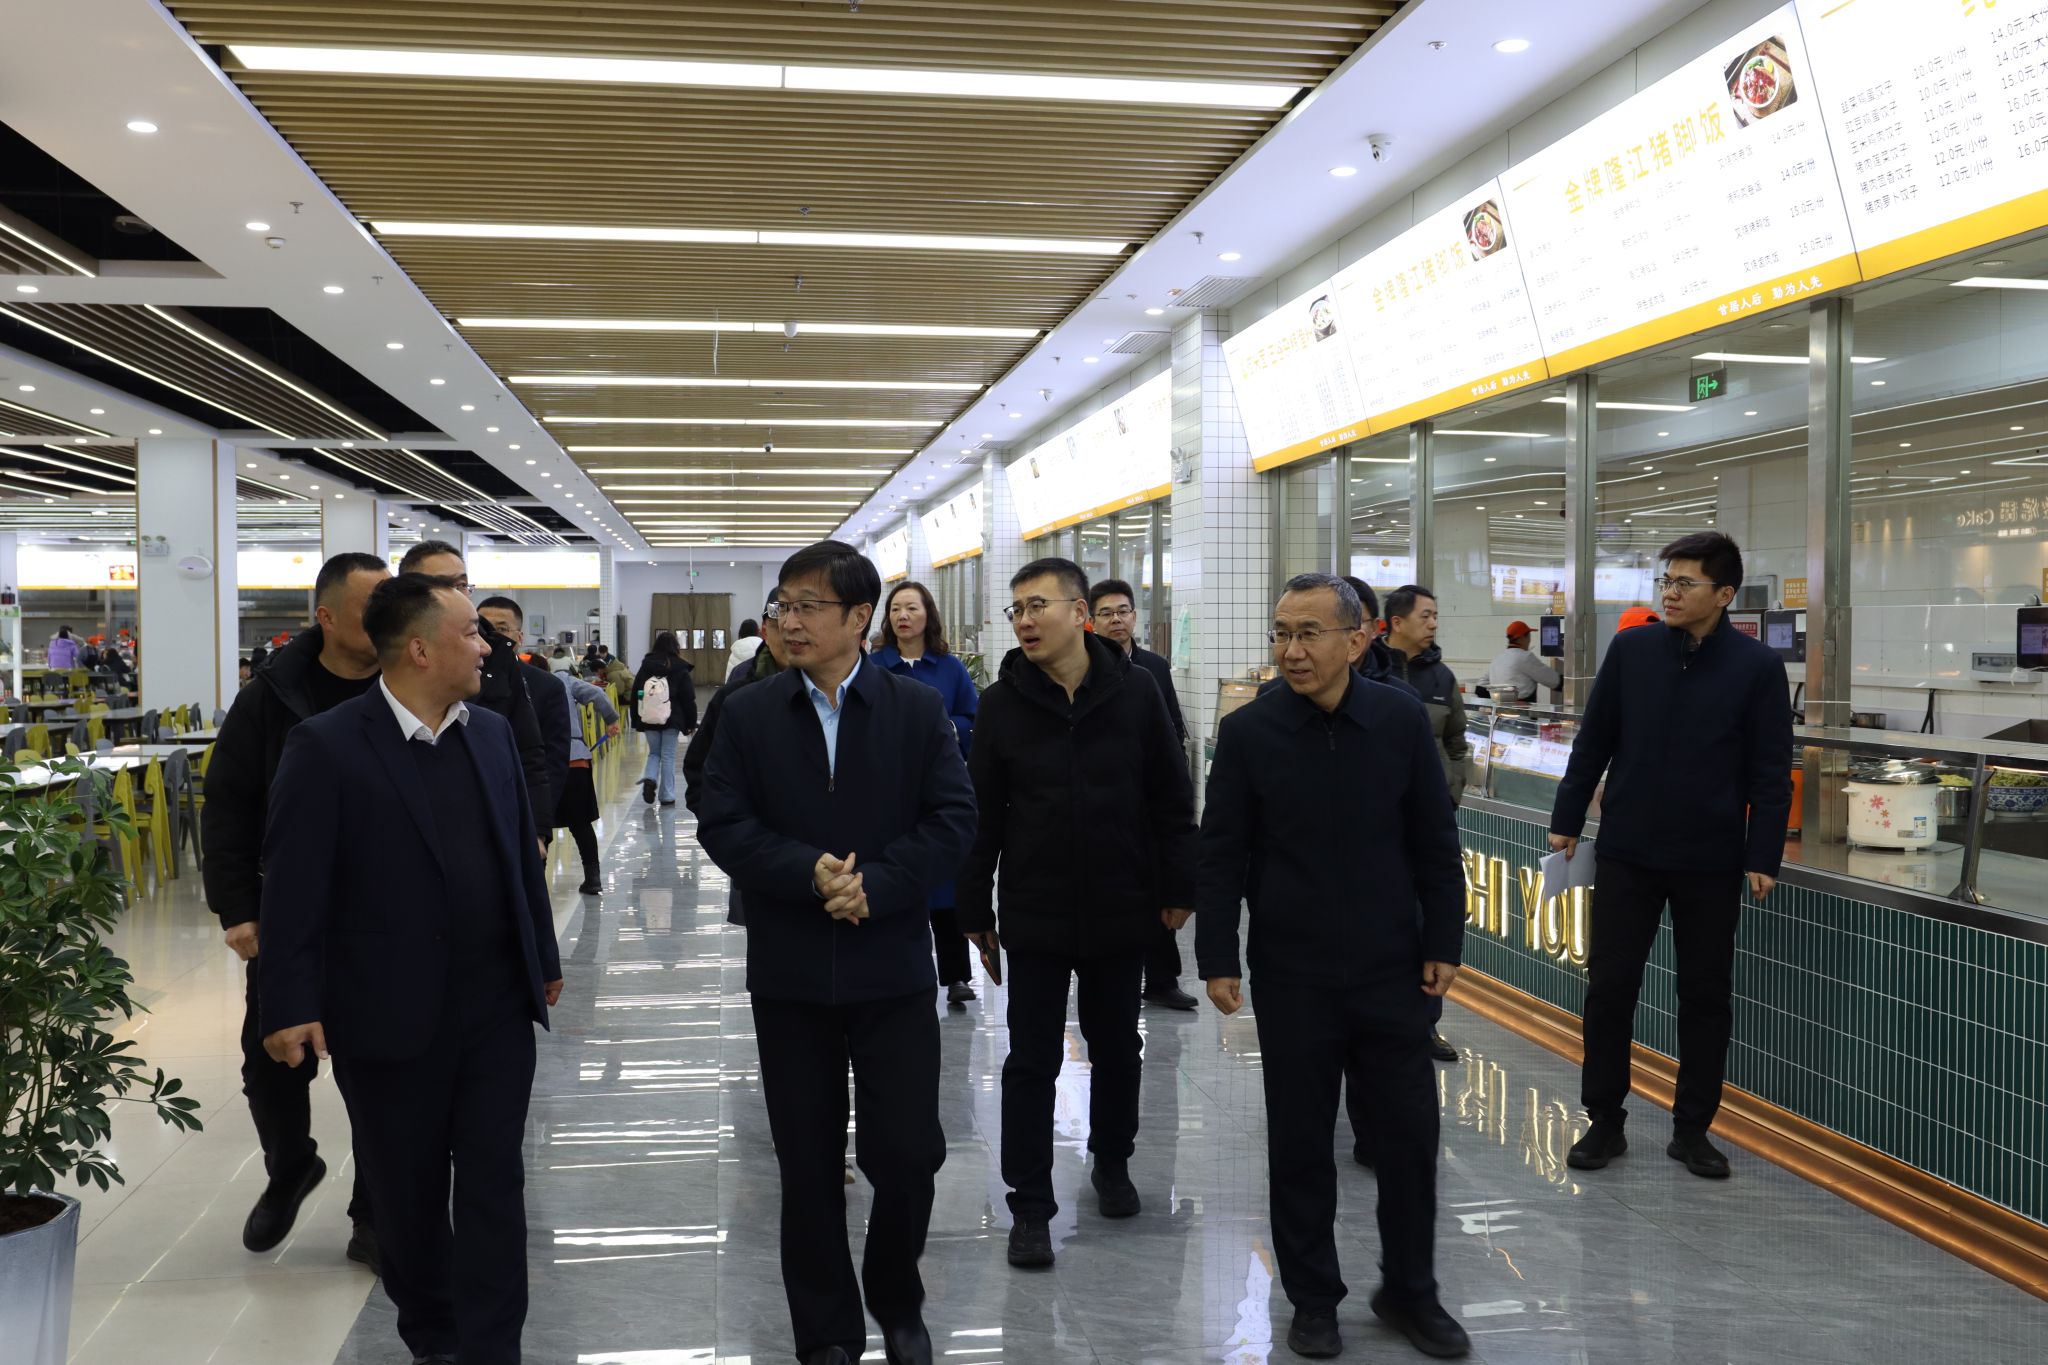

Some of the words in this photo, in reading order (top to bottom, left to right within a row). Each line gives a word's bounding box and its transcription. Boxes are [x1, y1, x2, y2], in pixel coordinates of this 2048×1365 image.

[1996, 33, 2048, 67] 14.0元/大
[1565, 101, 1726, 215] 金牌隆江猪脚饭
